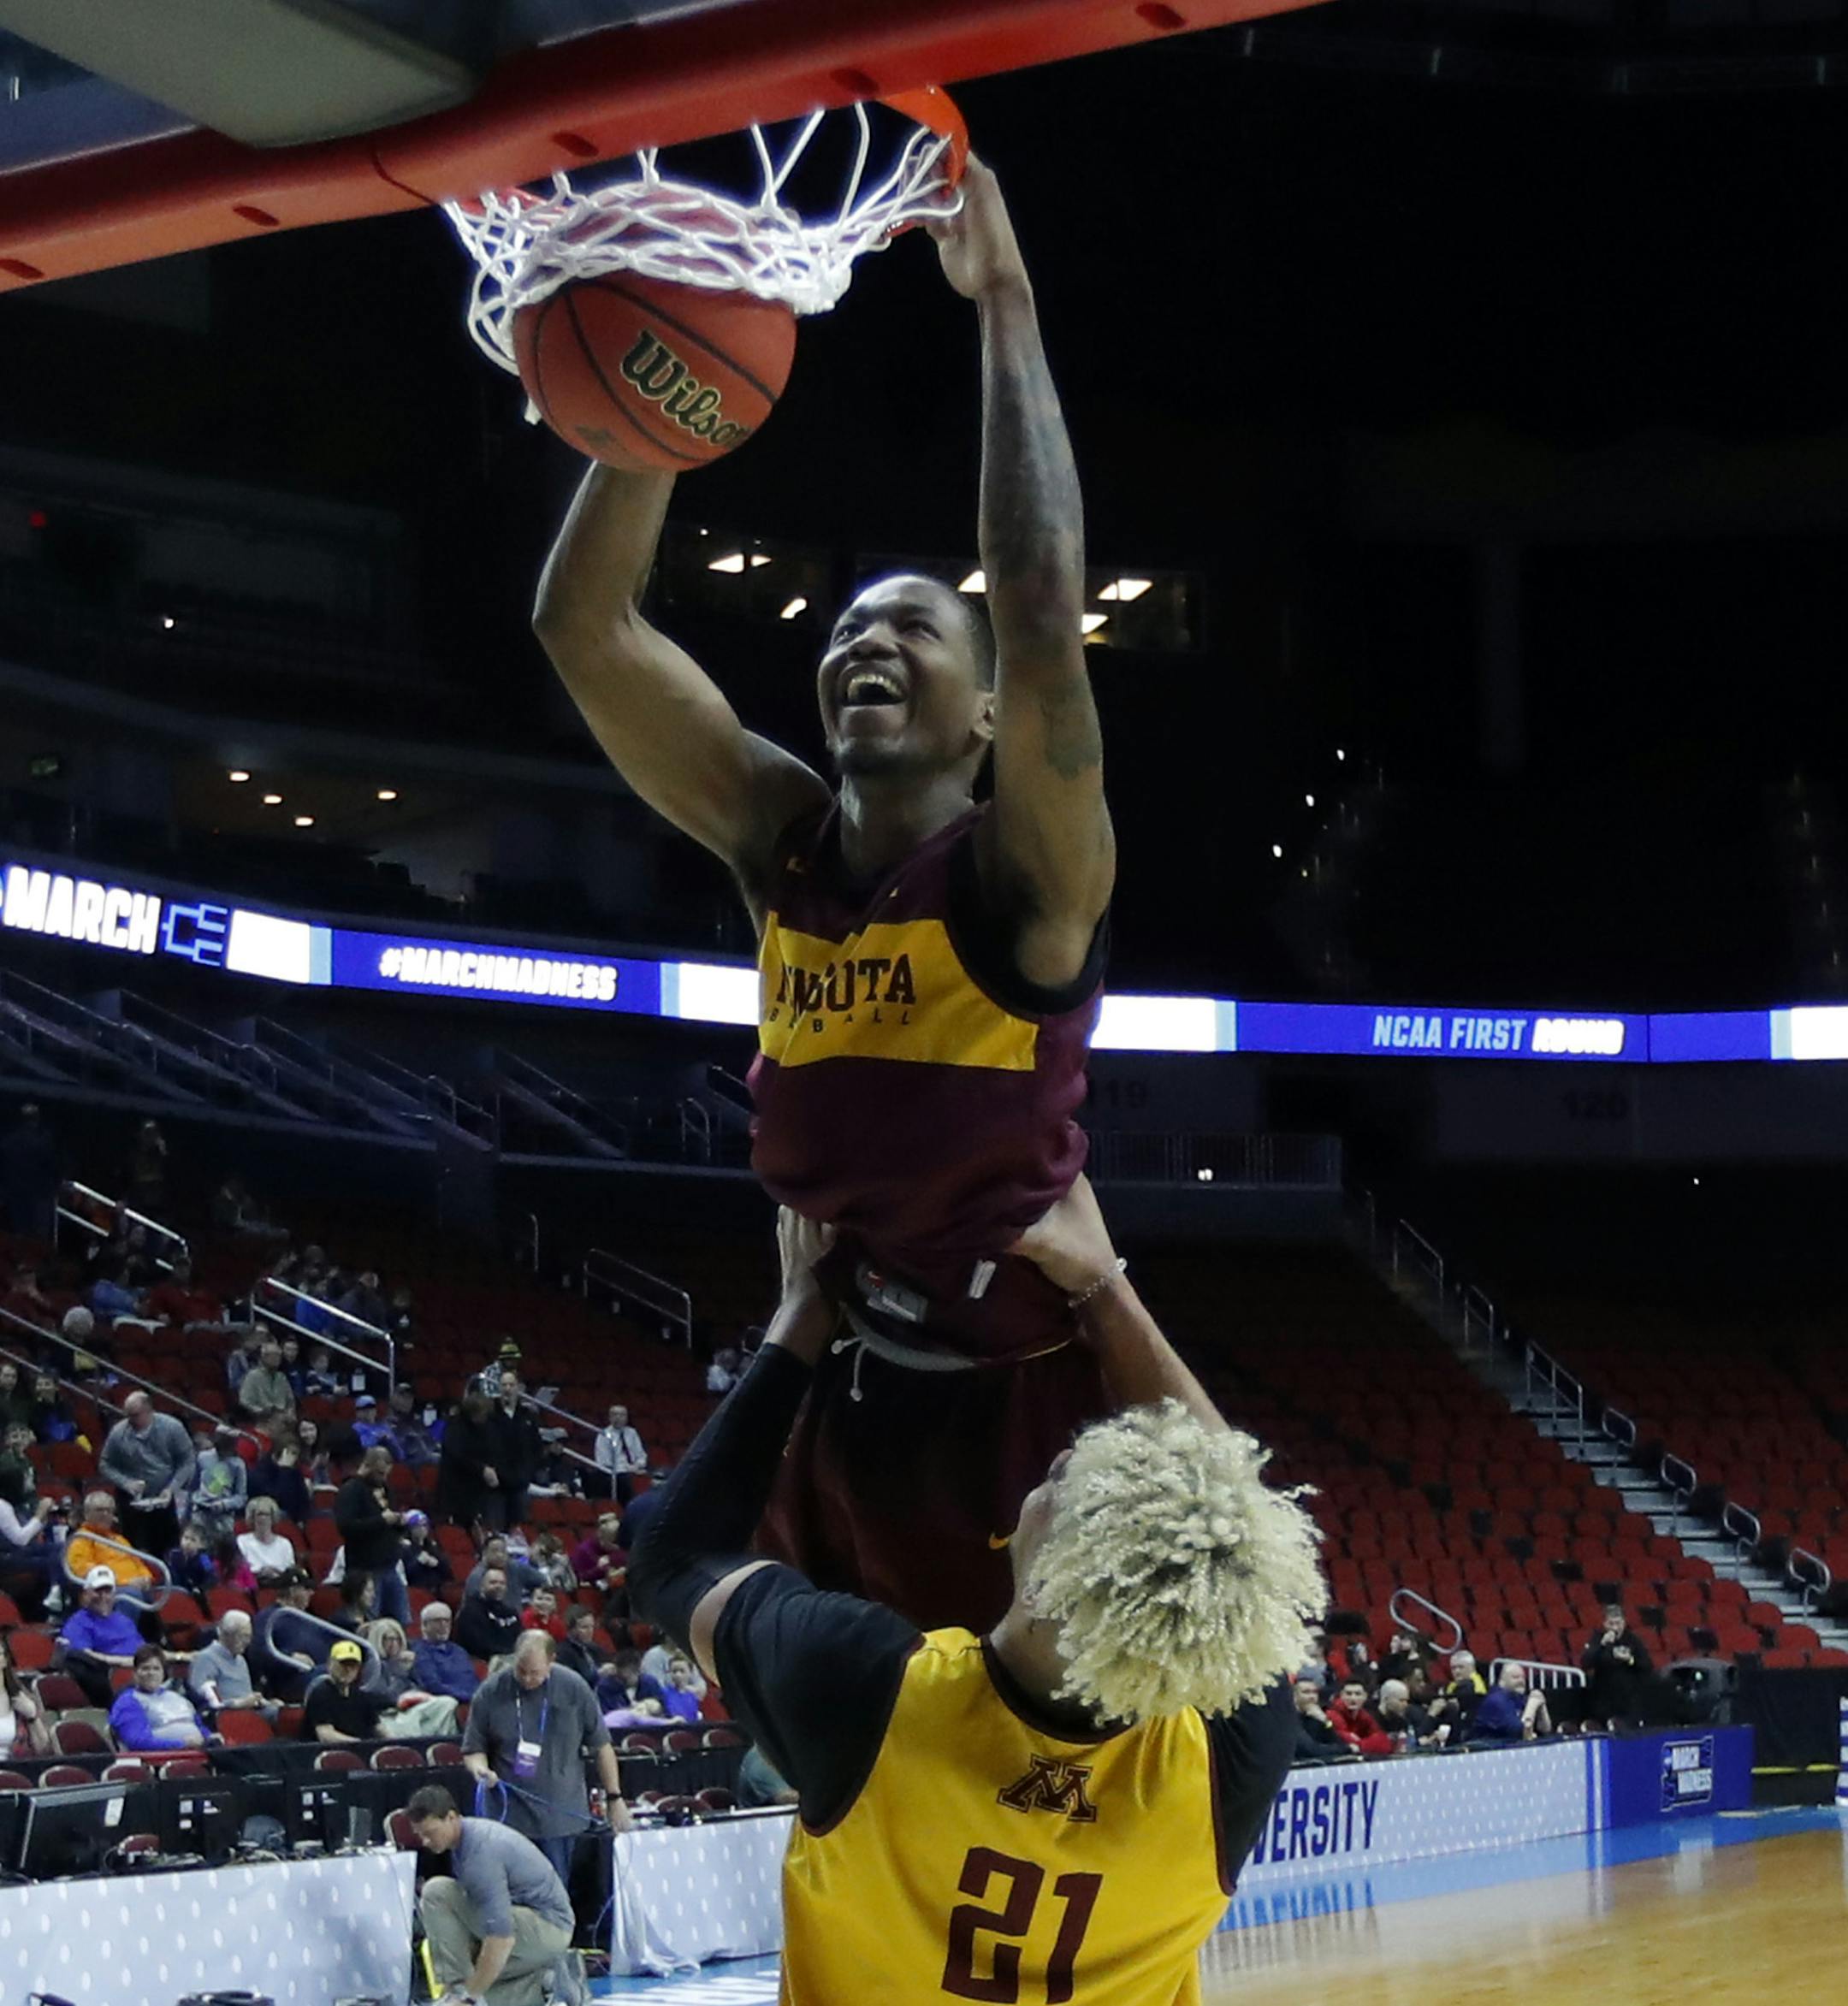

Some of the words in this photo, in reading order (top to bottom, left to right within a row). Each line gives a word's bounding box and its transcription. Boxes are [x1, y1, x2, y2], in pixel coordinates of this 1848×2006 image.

[3, 866, 162, 955] MARCH
[379, 946, 618, 1002] #MARCHMADNESS
[1372, 1015, 1442, 1048] NCAA
[1449, 1017, 1527, 1050] FIRST
[941, 1846, 1104, 2005] 21
